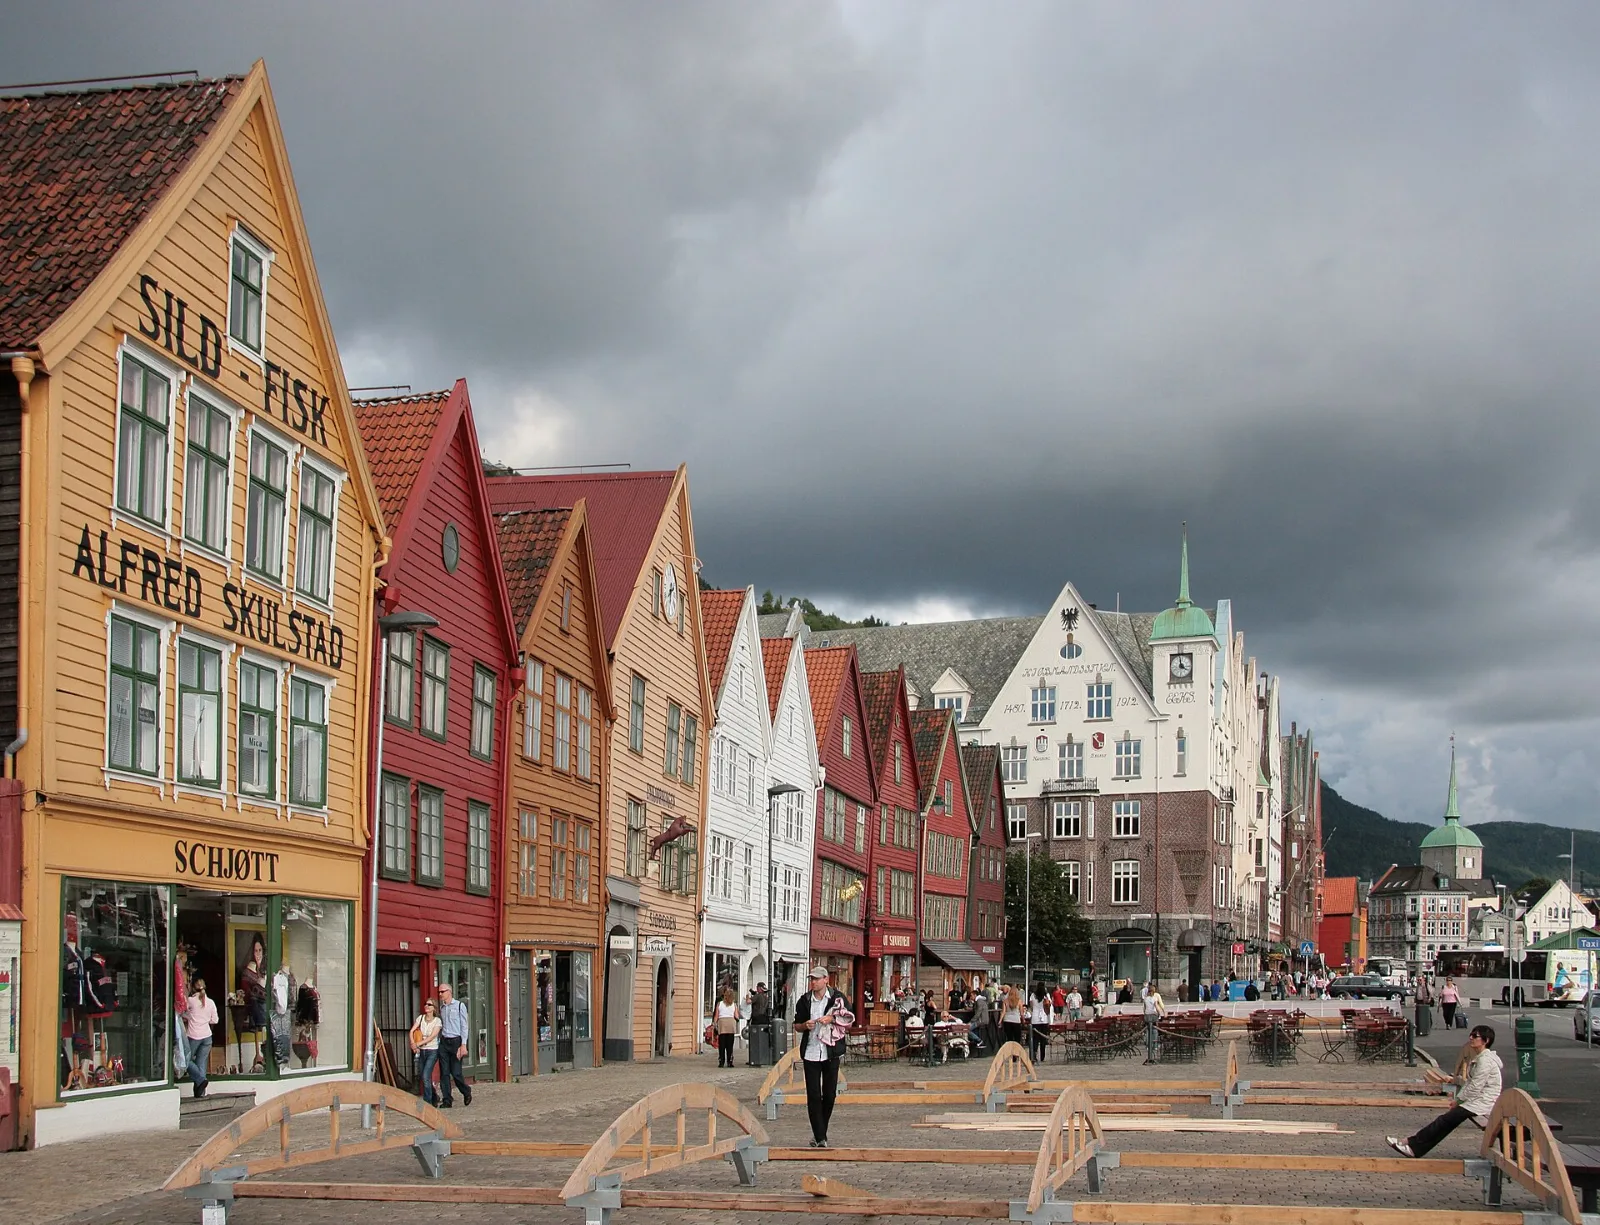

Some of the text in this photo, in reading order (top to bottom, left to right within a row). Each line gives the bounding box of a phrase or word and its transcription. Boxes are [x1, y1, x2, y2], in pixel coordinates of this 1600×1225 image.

[139, 274, 223, 380] SILD
[263, 361, 330, 447] FISK
[72, 523, 343, 669] ALFRED SKULSTAD
[174, 839, 280, 883] SCHJØTT
[1581, 939, 1599, 948] Taxi
